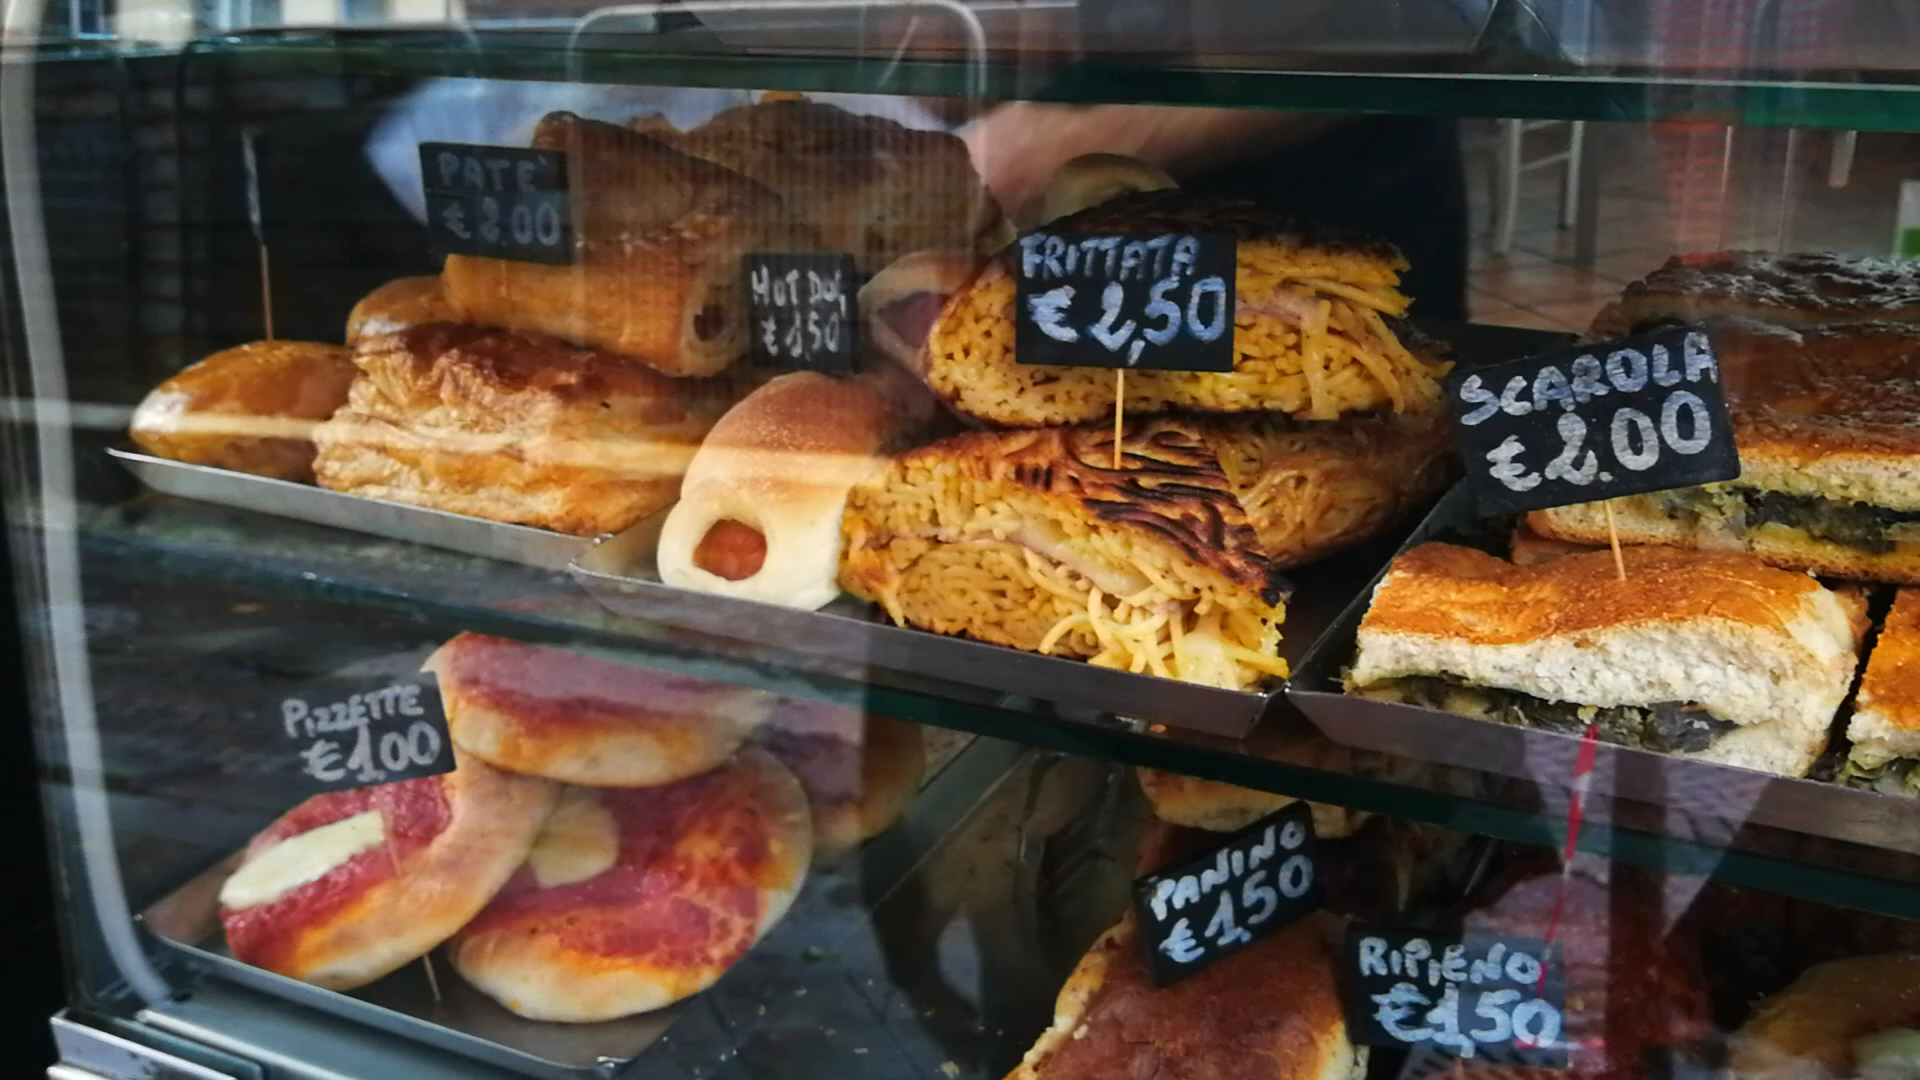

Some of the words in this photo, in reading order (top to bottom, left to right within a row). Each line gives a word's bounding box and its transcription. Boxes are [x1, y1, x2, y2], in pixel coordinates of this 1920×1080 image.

[1020, 233, 1200, 281] FRITTATA
[1459, 331, 1718, 426] SCAROLA
[1150, 819, 1306, 922] PANINO
[1359, 936, 1543, 987] RIPIENO
